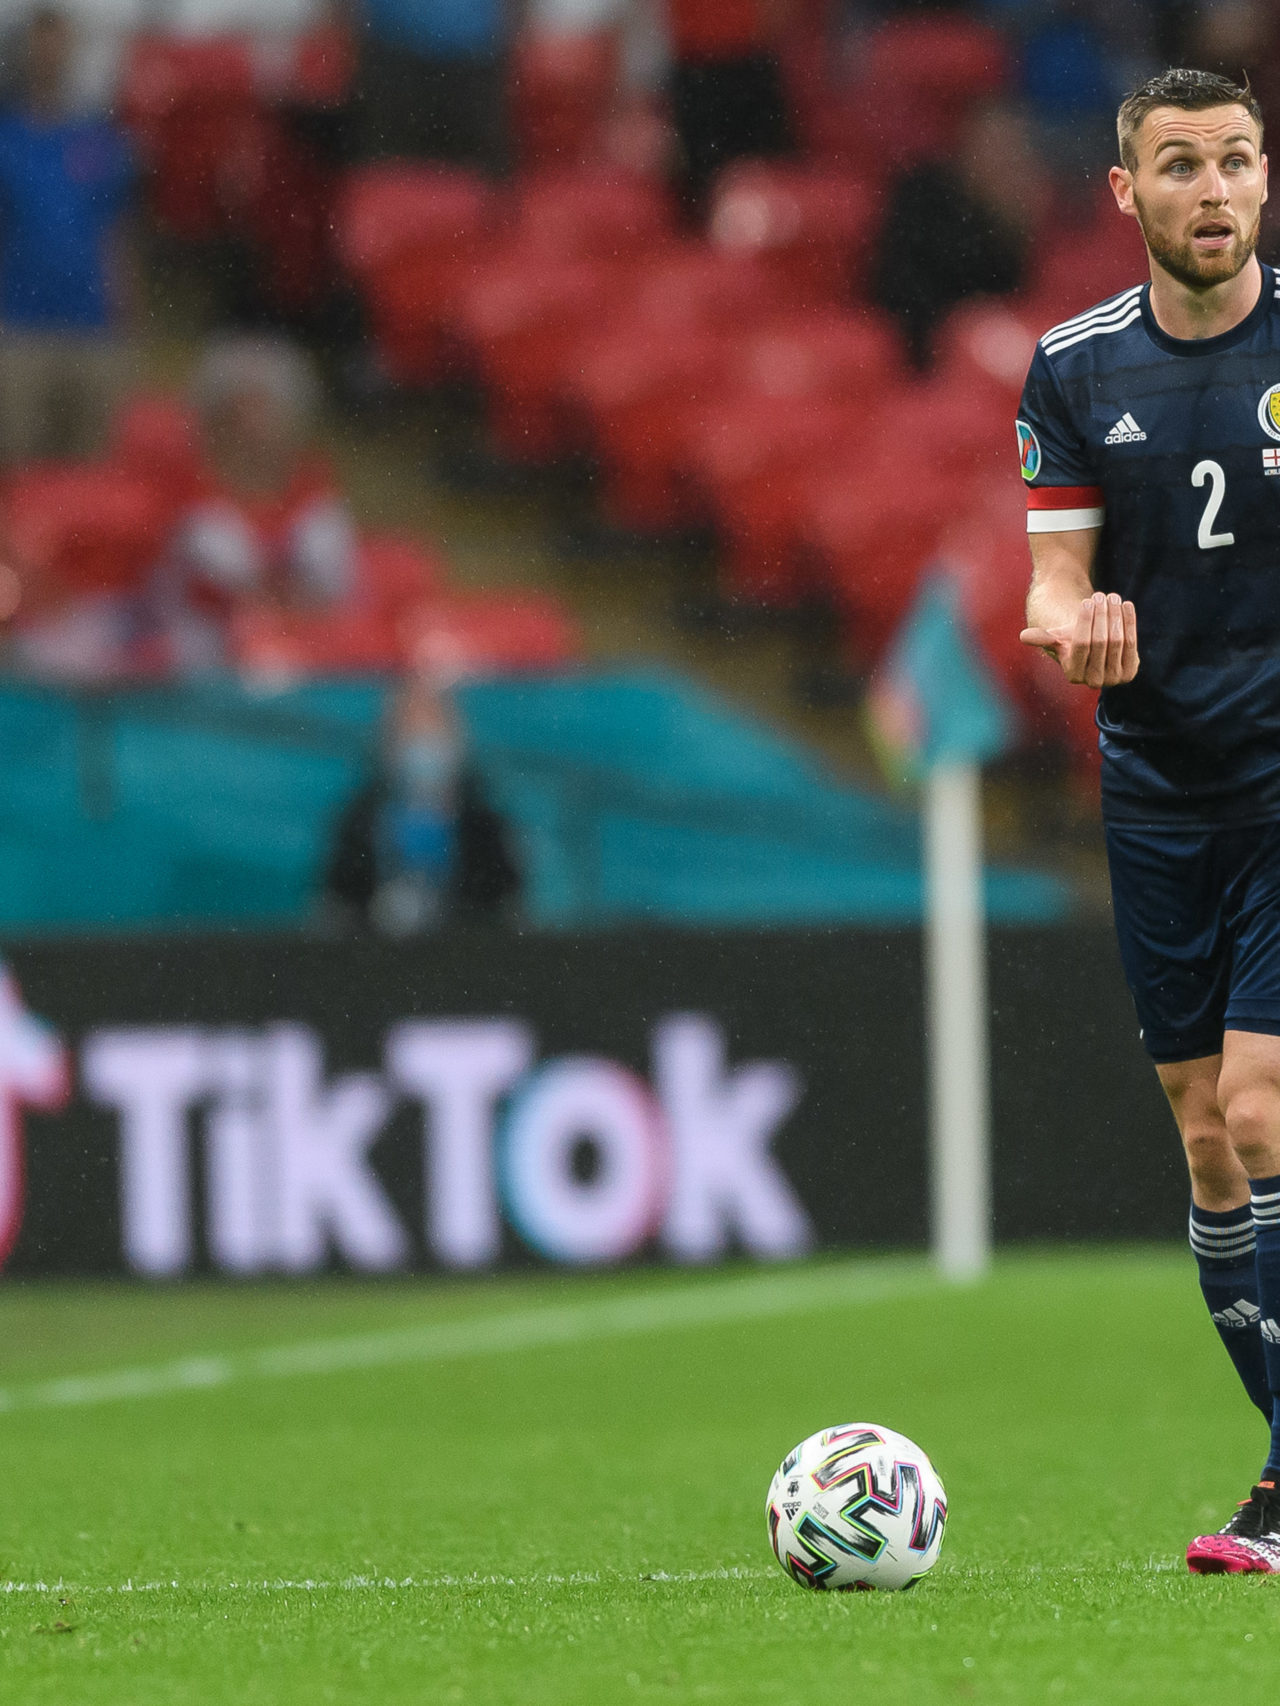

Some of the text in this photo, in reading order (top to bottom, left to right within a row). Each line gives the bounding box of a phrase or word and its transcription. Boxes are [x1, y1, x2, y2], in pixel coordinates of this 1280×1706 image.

[1104, 431, 1147, 445] adidas
[1191, 459, 1235, 549] 2
[82, 1009, 812, 1274] TikTok
